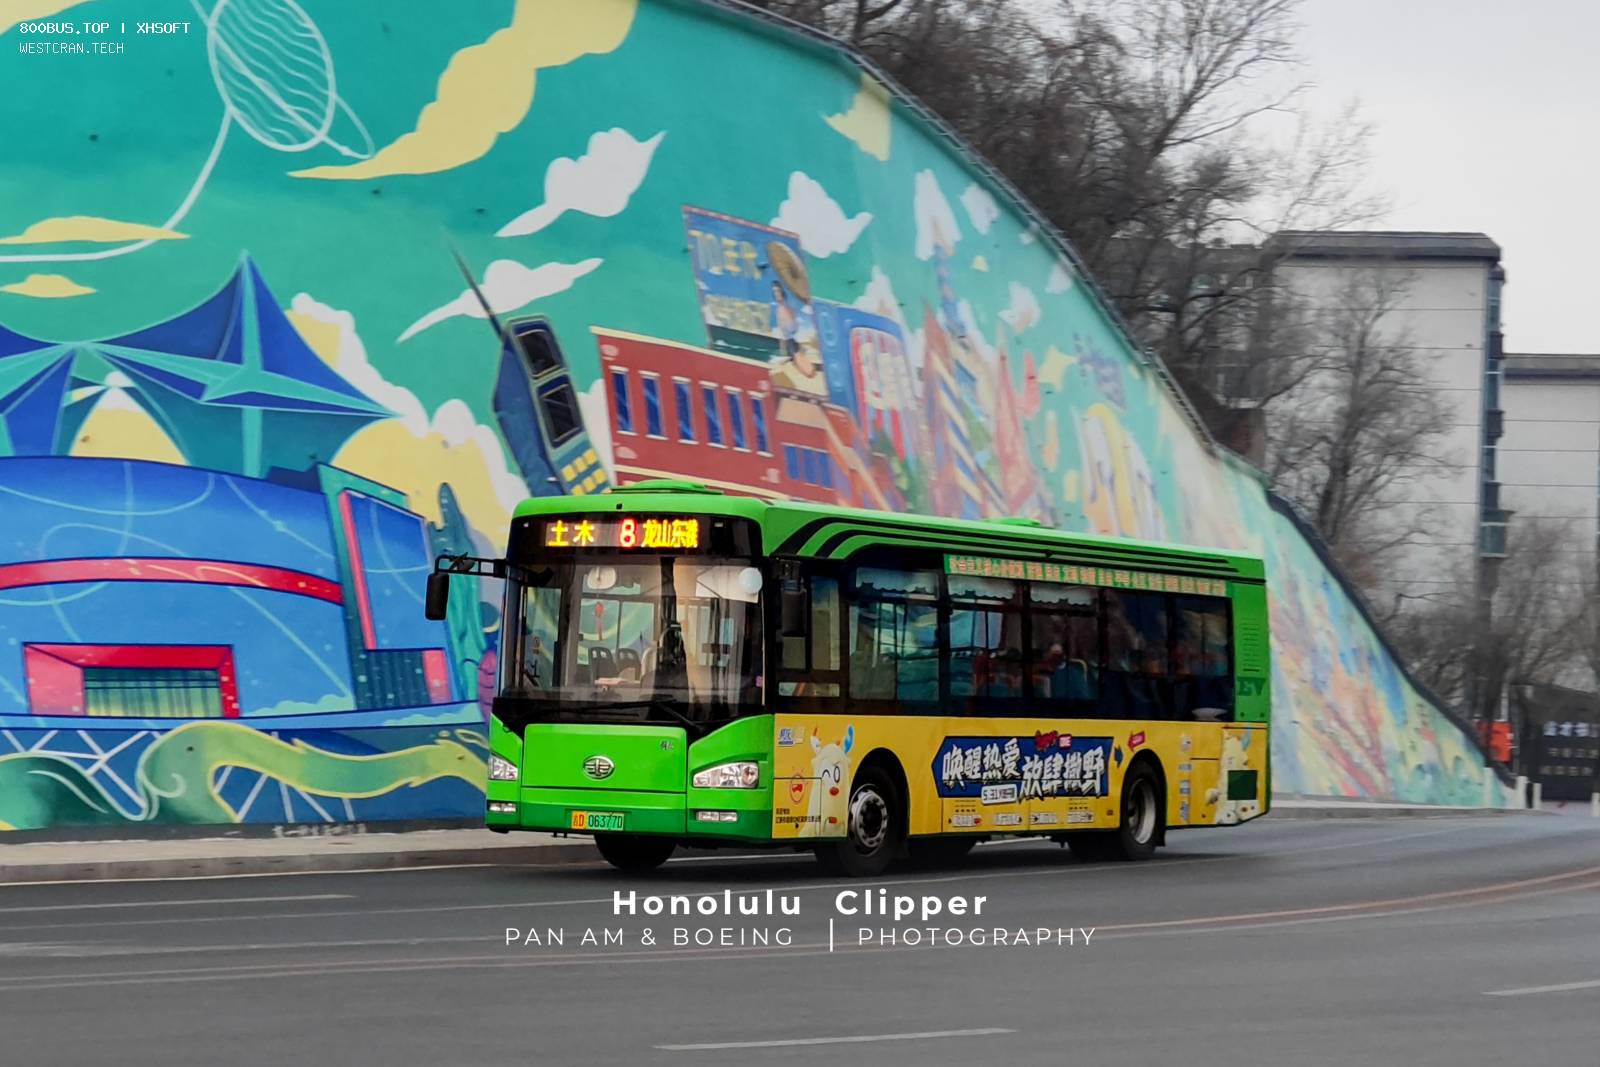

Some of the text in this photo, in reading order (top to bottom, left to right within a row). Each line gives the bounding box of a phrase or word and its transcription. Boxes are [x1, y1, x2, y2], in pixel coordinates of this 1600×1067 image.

[548, 519, 595, 547] 土木
[620, 518, 636, 548] 8
[942, 738, 1021, 790] 唤醒热爱
